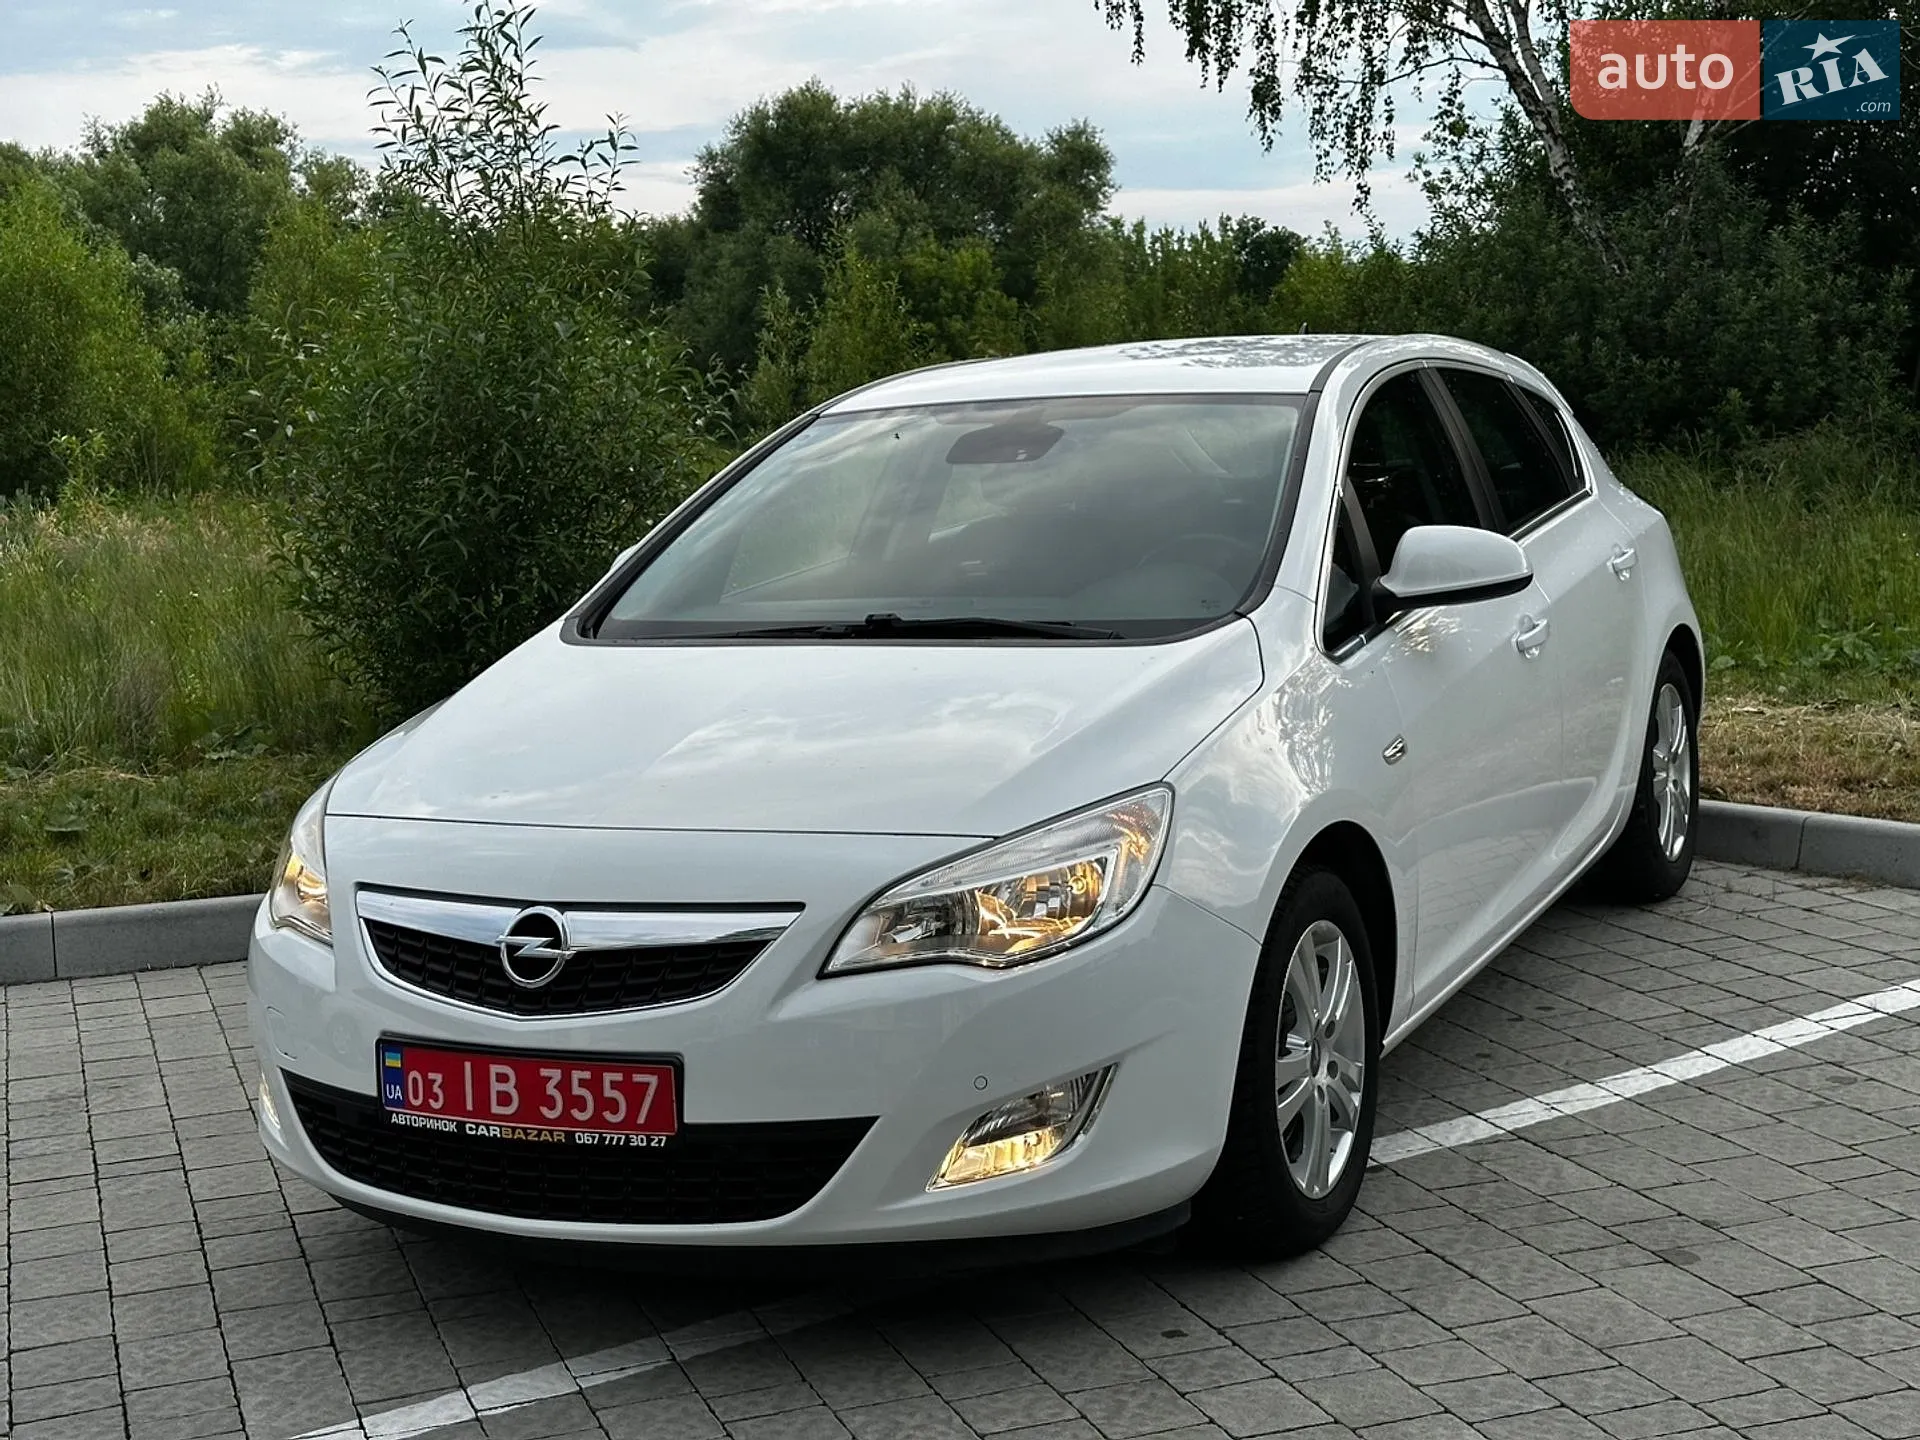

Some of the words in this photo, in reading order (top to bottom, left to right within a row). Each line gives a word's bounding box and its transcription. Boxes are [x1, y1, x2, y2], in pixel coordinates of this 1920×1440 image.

[386, 1083, 403, 1101] UA
[408, 1069, 445, 1110] 03
[540, 1067, 659, 1125] 3557
[390, 1112, 457, 1133] АВТОРИНОК
[465, 1123, 566, 1143] CARBAZAR
[575, 1132, 600, 1145] 067
[602, 1133, 626, 1146] 777
[629, 1134, 647, 1147] 30
[650, 1135, 667, 1147] 27
